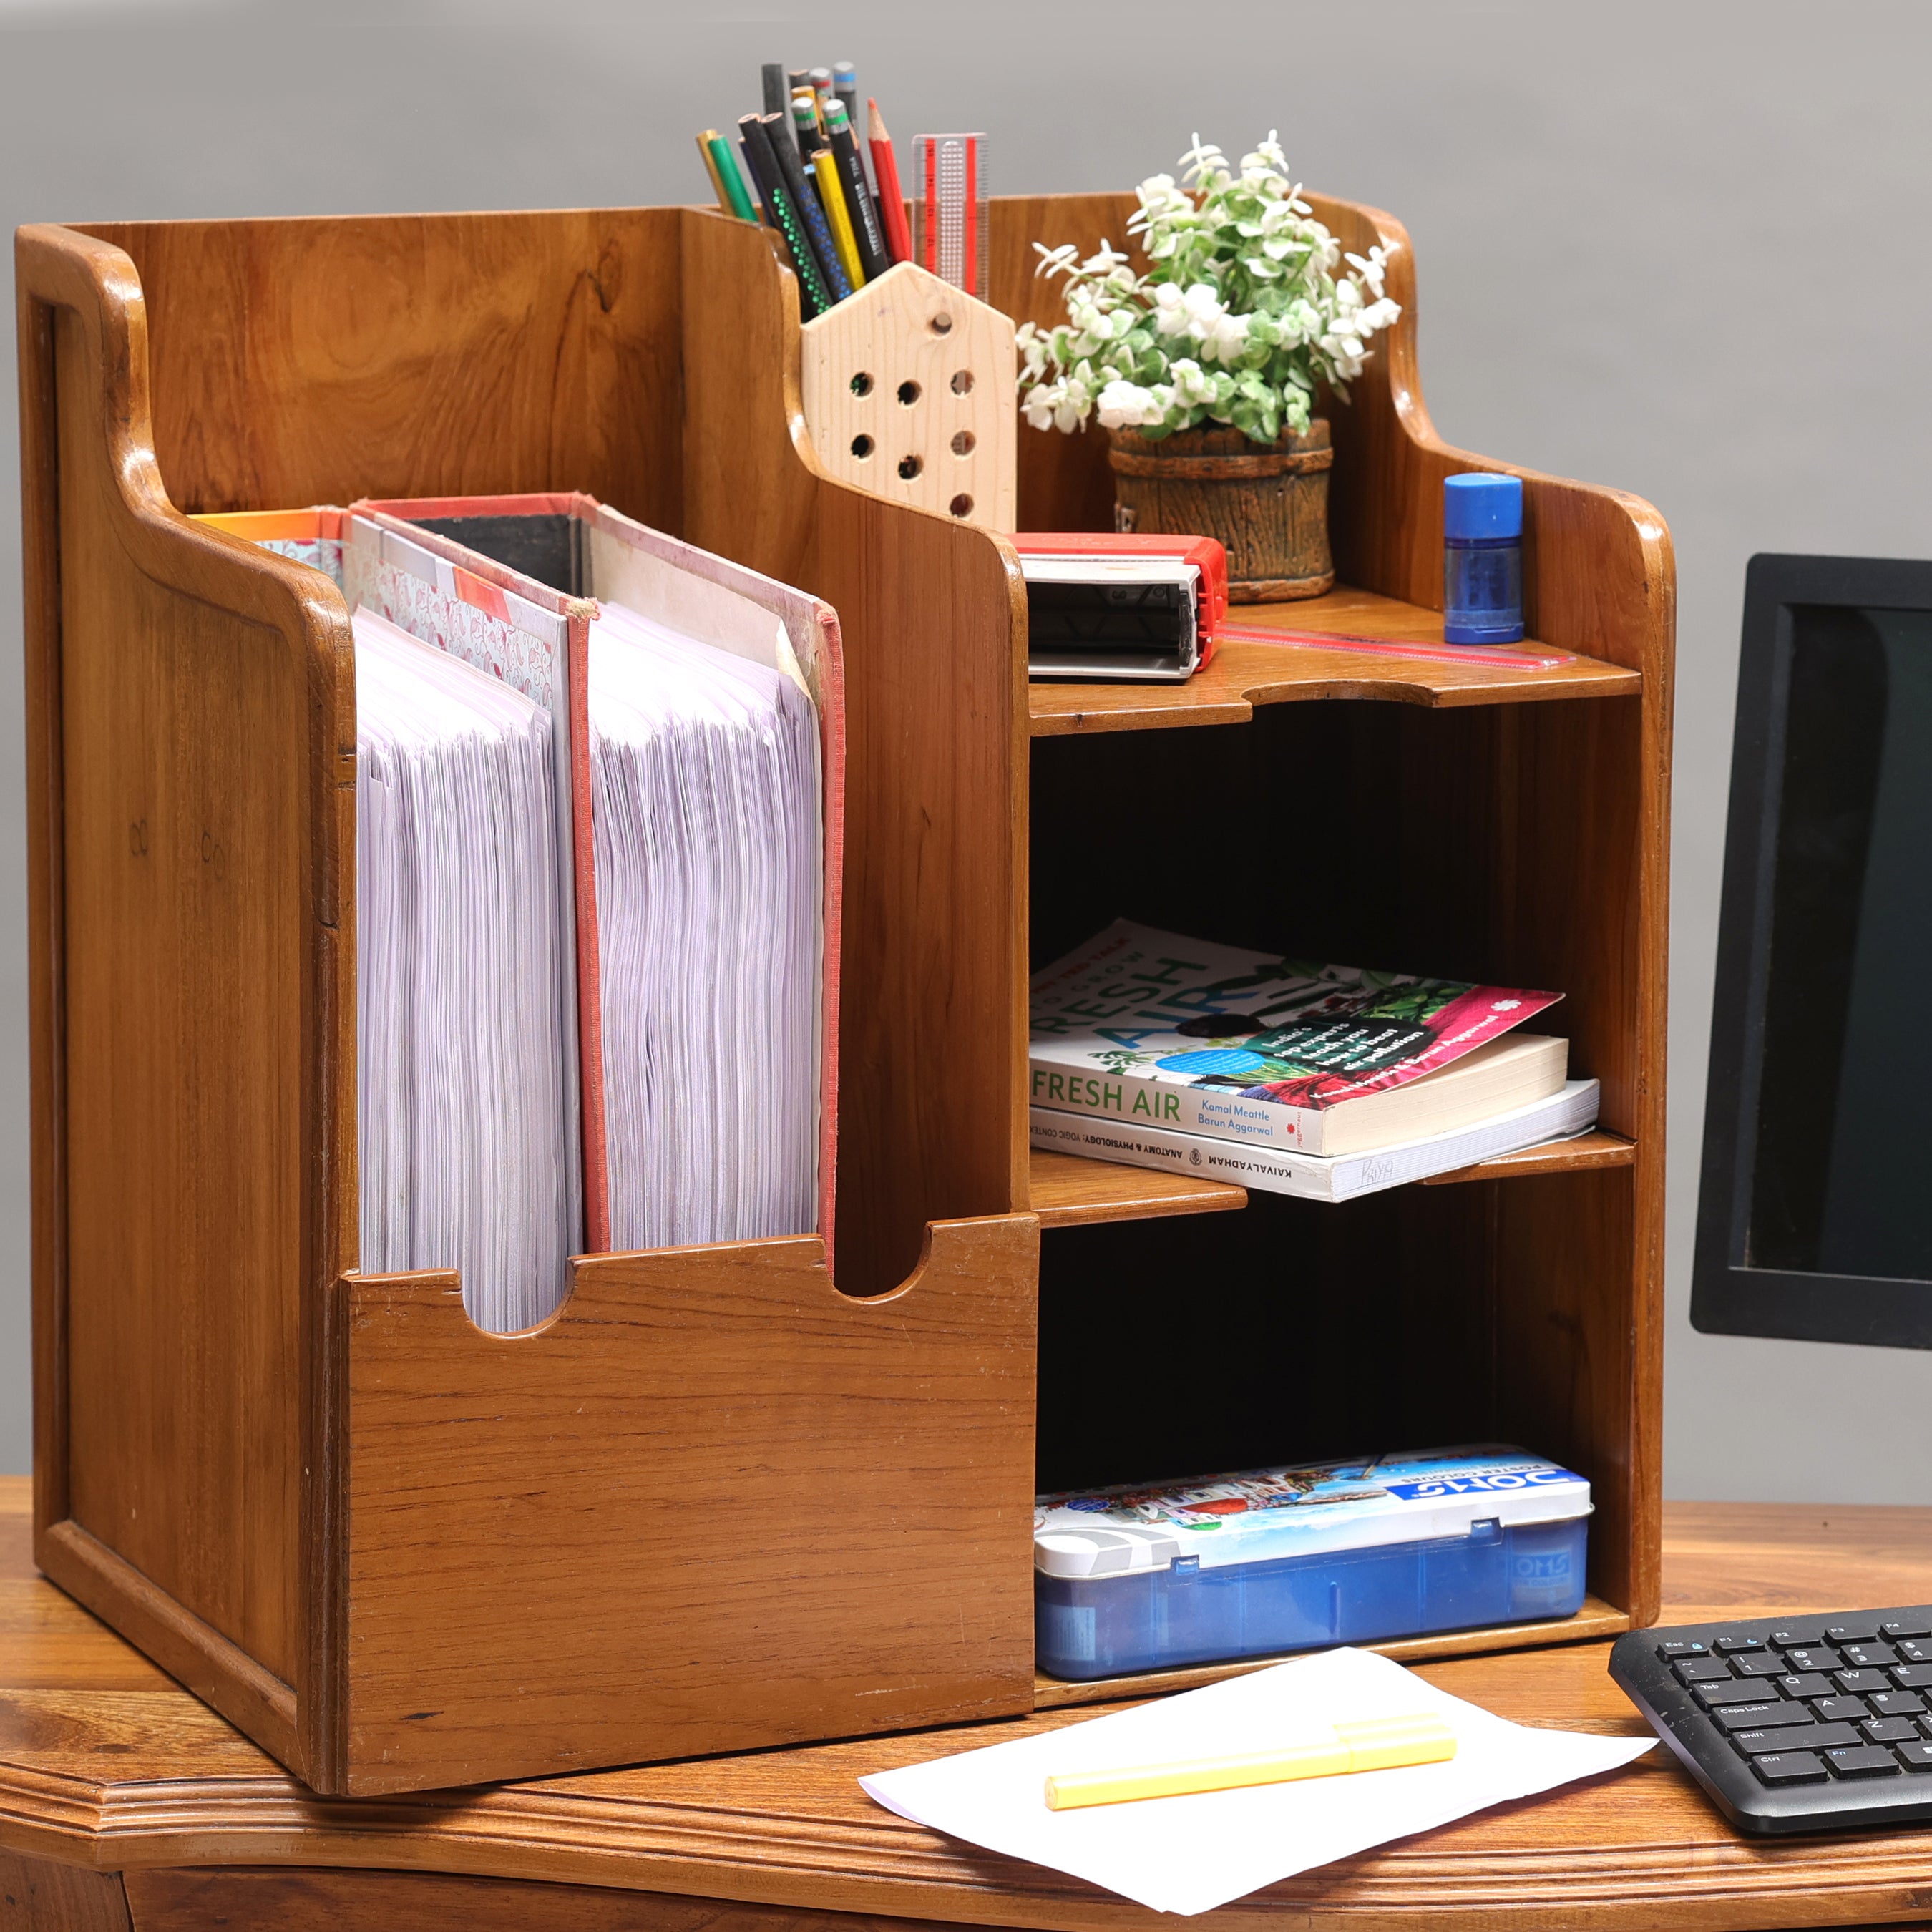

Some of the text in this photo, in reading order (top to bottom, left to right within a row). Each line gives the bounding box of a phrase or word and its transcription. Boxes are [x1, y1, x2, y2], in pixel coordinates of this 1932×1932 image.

[1029, 957, 1209, 1035] RESH
[1092, 986, 1261, 1050] AIR
[1261, 1025, 1312, 1048] India's
[1274, 1022, 1350, 1058] top experts
[1302, 1028, 1369, 1060] teach you
[1315, 1028, 1398, 1066] how to beat
[1343, 1030, 1424, 1071] air pollution
[1309, 1014, 1500, 1099] Kamal Meattle & Barun Aggarwal
[1033, 1070, 1181, 1122] FRESH AIR
[1201, 1099, 1270, 1121] Kamal Meattle
[1059, 1131, 1081, 1142] YOGIC
[1198, 1113, 1274, 1137] Barun Aggarwal
[1083, 1134, 1134, 1151] PHYSIOLOGY:
[1135, 1143, 1142, 1151] &
[1143, 1145, 1183, 1158] ANATOMY
[1209, 1156, 1292, 1178] KAIVALYADHAM
[1361, 1158, 1393, 1187] PRIYA
[1400, 1464, 1543, 1483] POSTER COLOURS
[1418, 1470, 1571, 1498] DOMS
